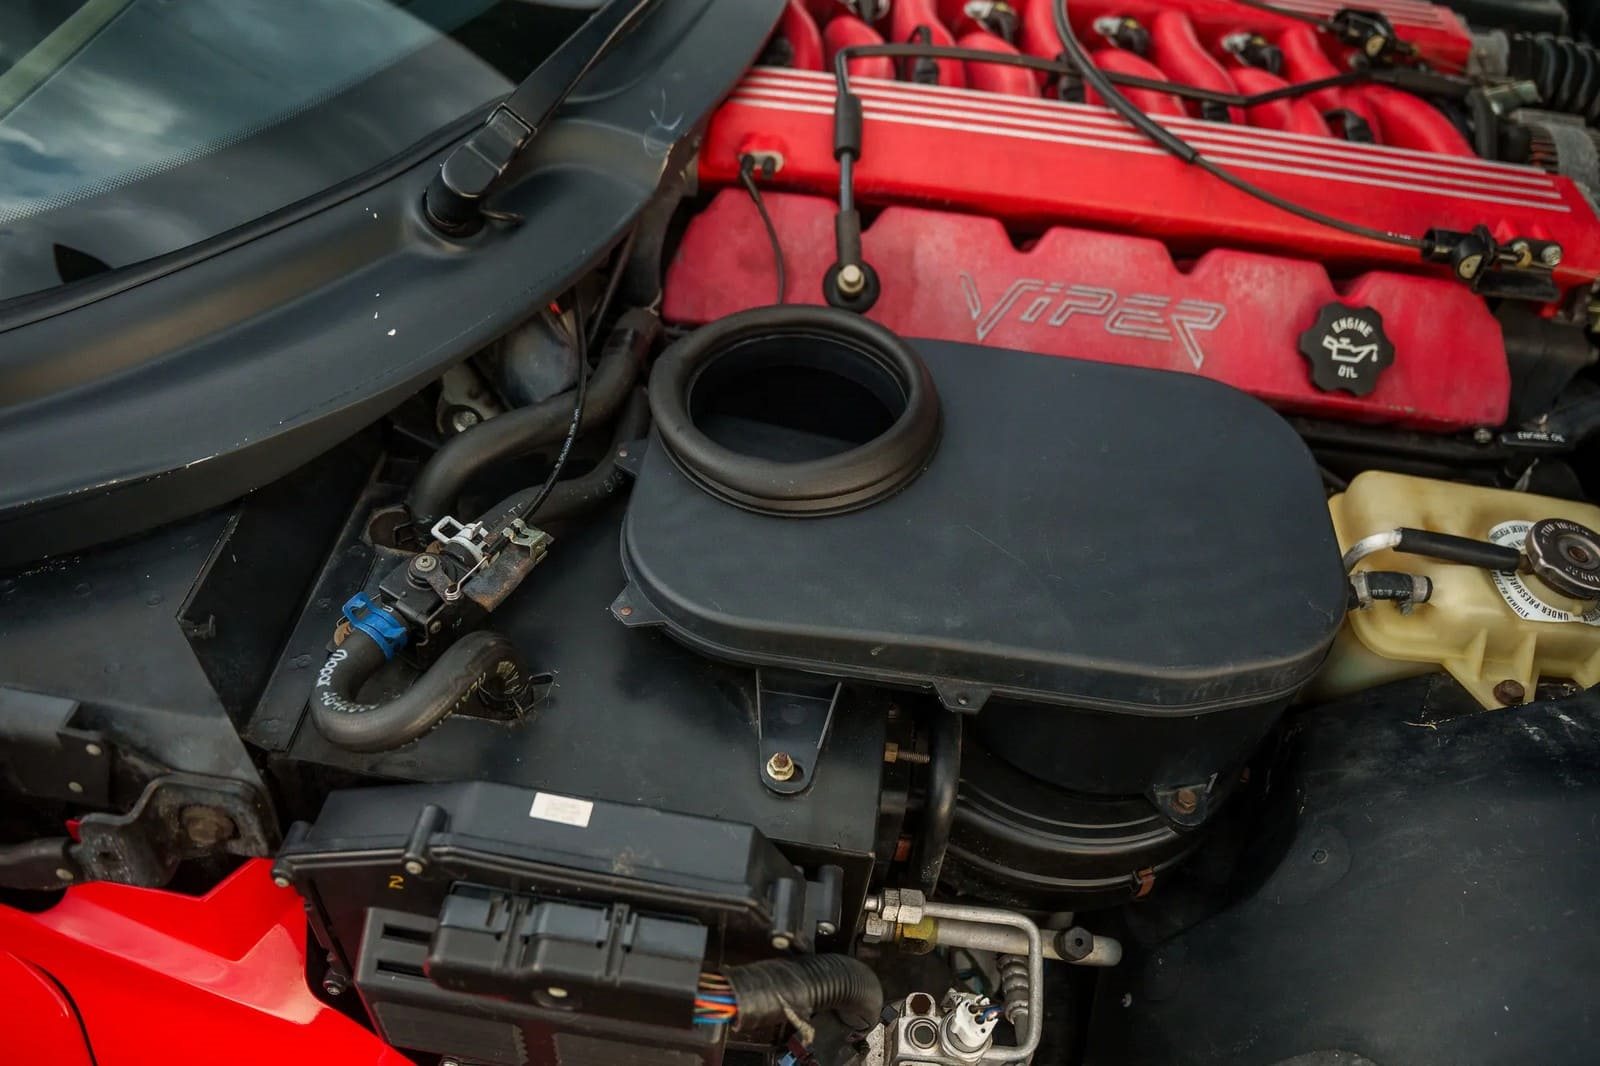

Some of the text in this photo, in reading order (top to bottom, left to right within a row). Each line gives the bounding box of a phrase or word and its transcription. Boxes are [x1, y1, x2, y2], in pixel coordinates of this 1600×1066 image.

[1331, 317, 1374, 338] ENGINE
[1337, 364, 1359, 379] OIL
[1507, 576, 1541, 610] PRESSURE
[1541, 606, 1569, 621] UNDER
[388, 874, 404, 890] 2
